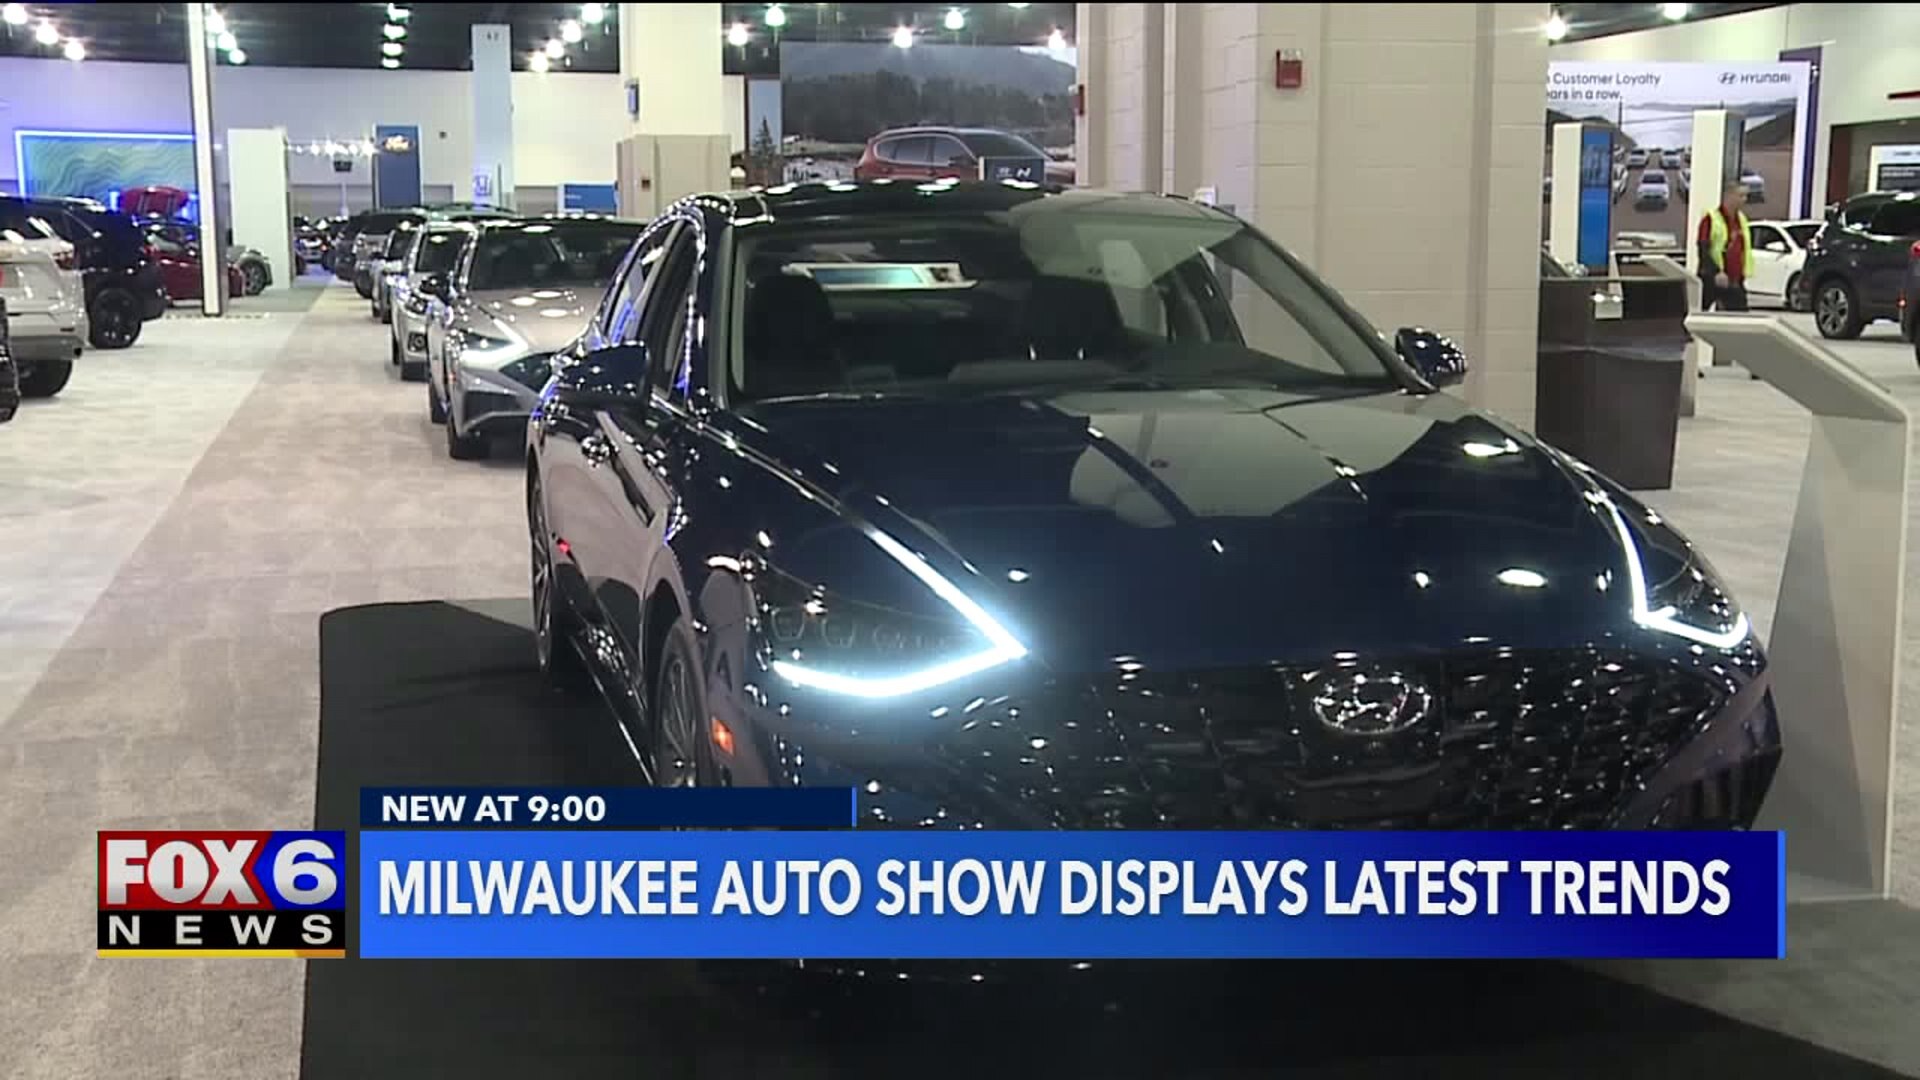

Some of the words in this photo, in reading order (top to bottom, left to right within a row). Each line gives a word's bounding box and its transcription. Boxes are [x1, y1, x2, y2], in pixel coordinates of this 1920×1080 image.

[1553, 72, 1612, 85] Customer
[1616, 72, 1661, 87] Loyalty
[1740, 73, 1791, 84] HYUNDAI
[1546, 90, 1569, 100] ars
[1585, 90, 1594, 100] a
